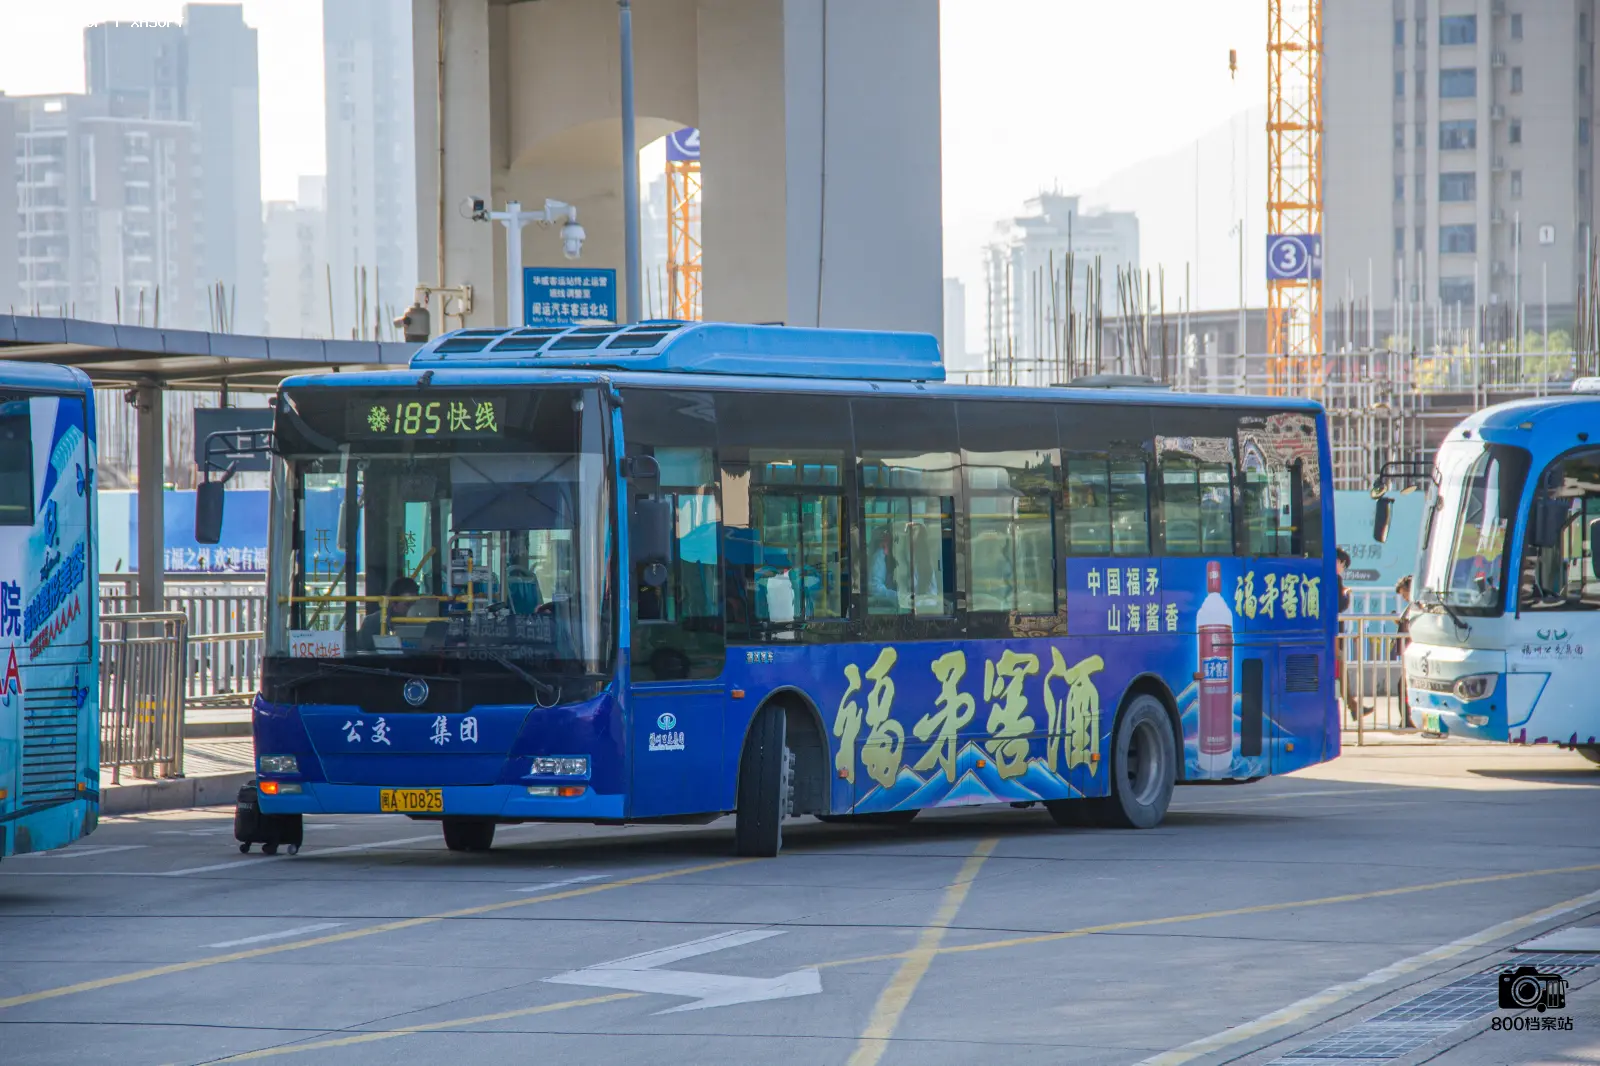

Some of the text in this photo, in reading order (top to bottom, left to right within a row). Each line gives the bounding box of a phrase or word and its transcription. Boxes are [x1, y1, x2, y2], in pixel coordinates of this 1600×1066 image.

[394, 402, 498, 435] 185快线
[1087, 567, 1159, 597] 中国福矛
[1108, 603, 1179, 632] 山海酱香
[342, 715, 478, 746] 公交 集团
